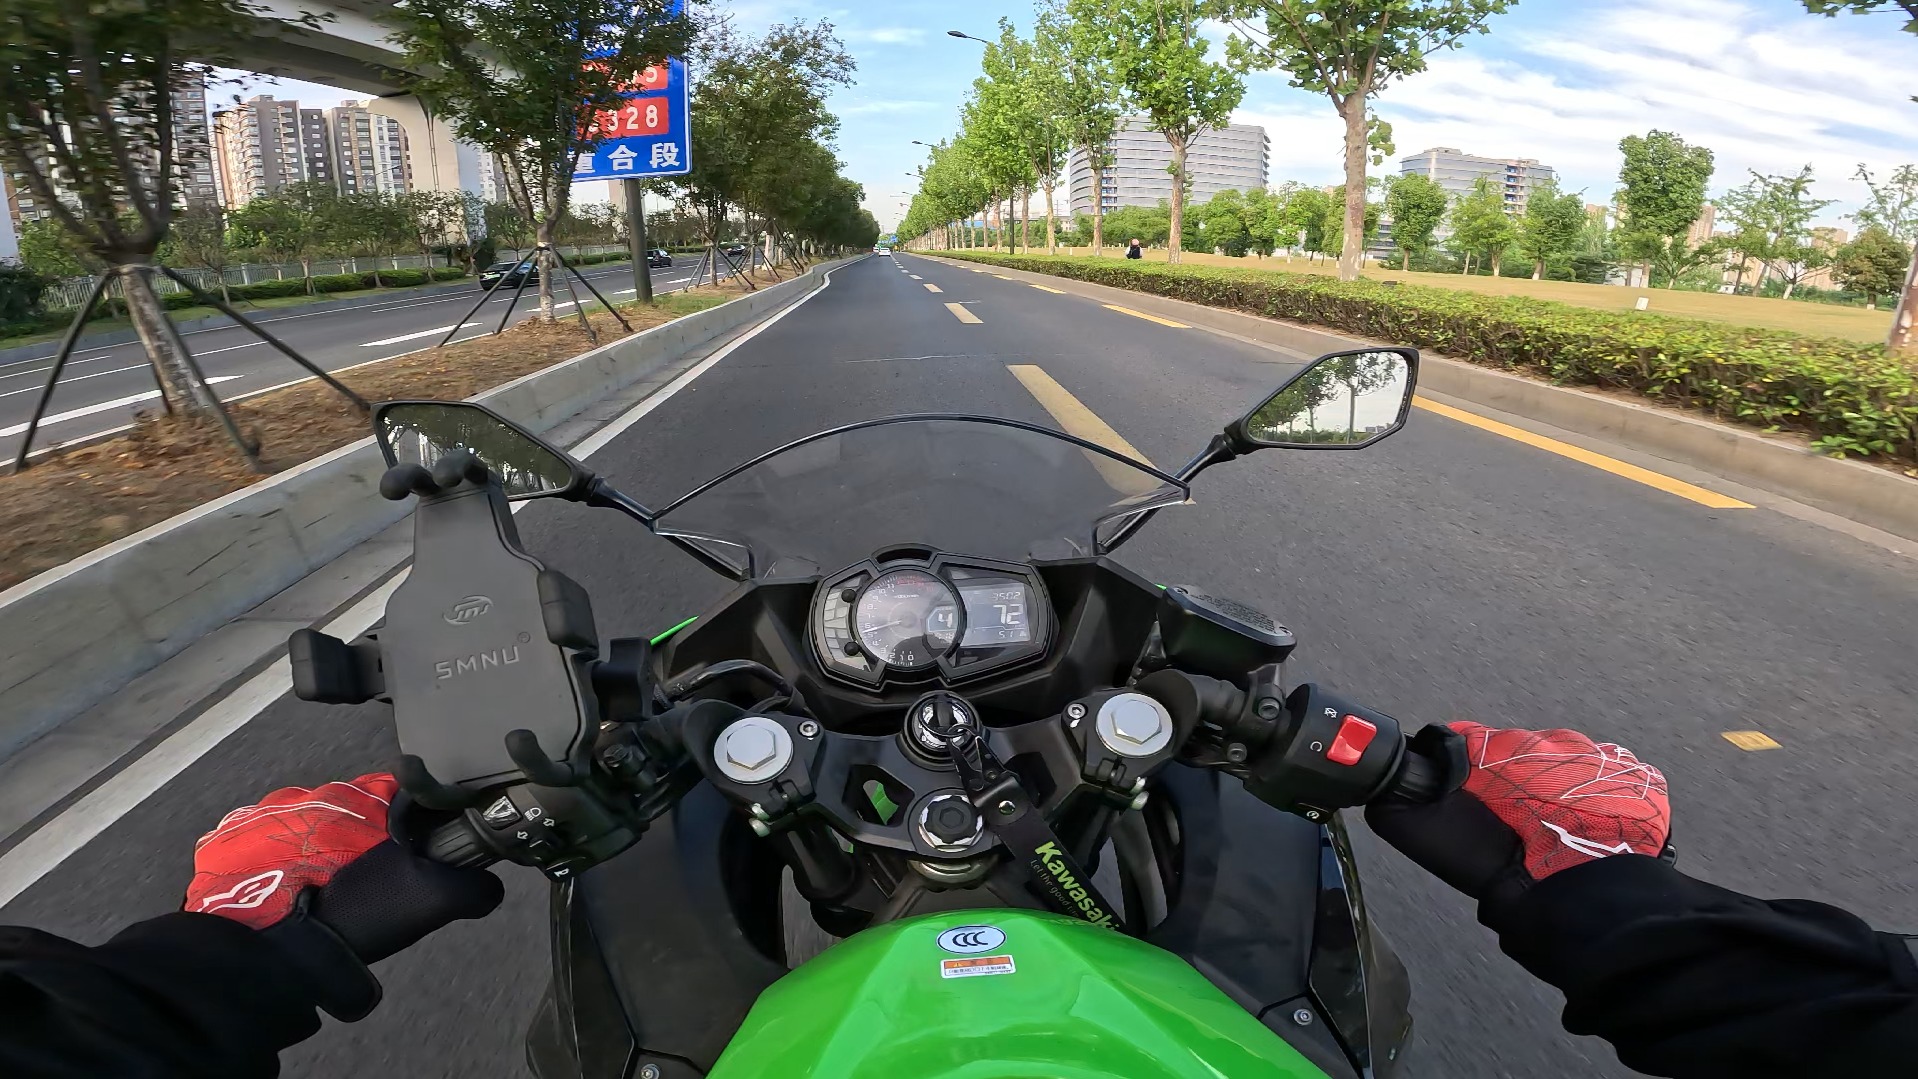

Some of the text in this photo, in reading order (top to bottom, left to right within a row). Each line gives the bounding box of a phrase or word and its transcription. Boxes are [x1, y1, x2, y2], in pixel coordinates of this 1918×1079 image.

[938, 612, 953, 628] 4
[993, 603, 1024, 625] 72
[434, 645, 520, 680] SMNU
[952, 931, 988, 947] CCC
